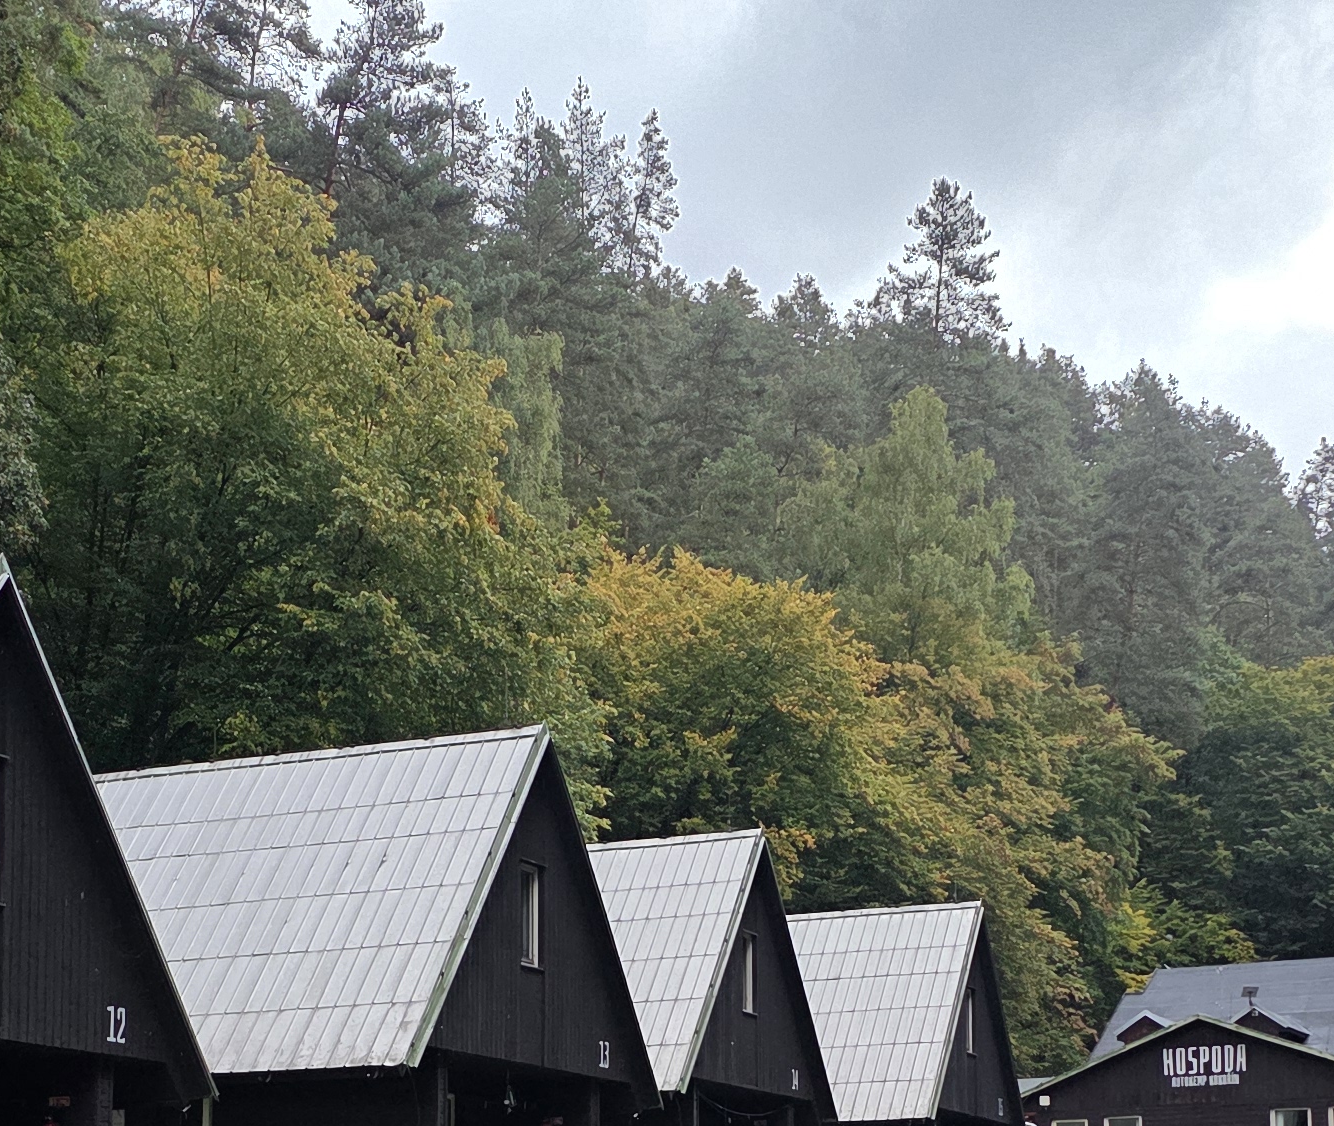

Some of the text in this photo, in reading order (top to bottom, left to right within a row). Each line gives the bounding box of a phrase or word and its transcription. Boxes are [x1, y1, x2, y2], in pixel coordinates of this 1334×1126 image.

[106, 1005, 126, 1044] 12
[598, 1040, 610, 1069] 13
[1162, 1043, 1247, 1076] HOSPODA
